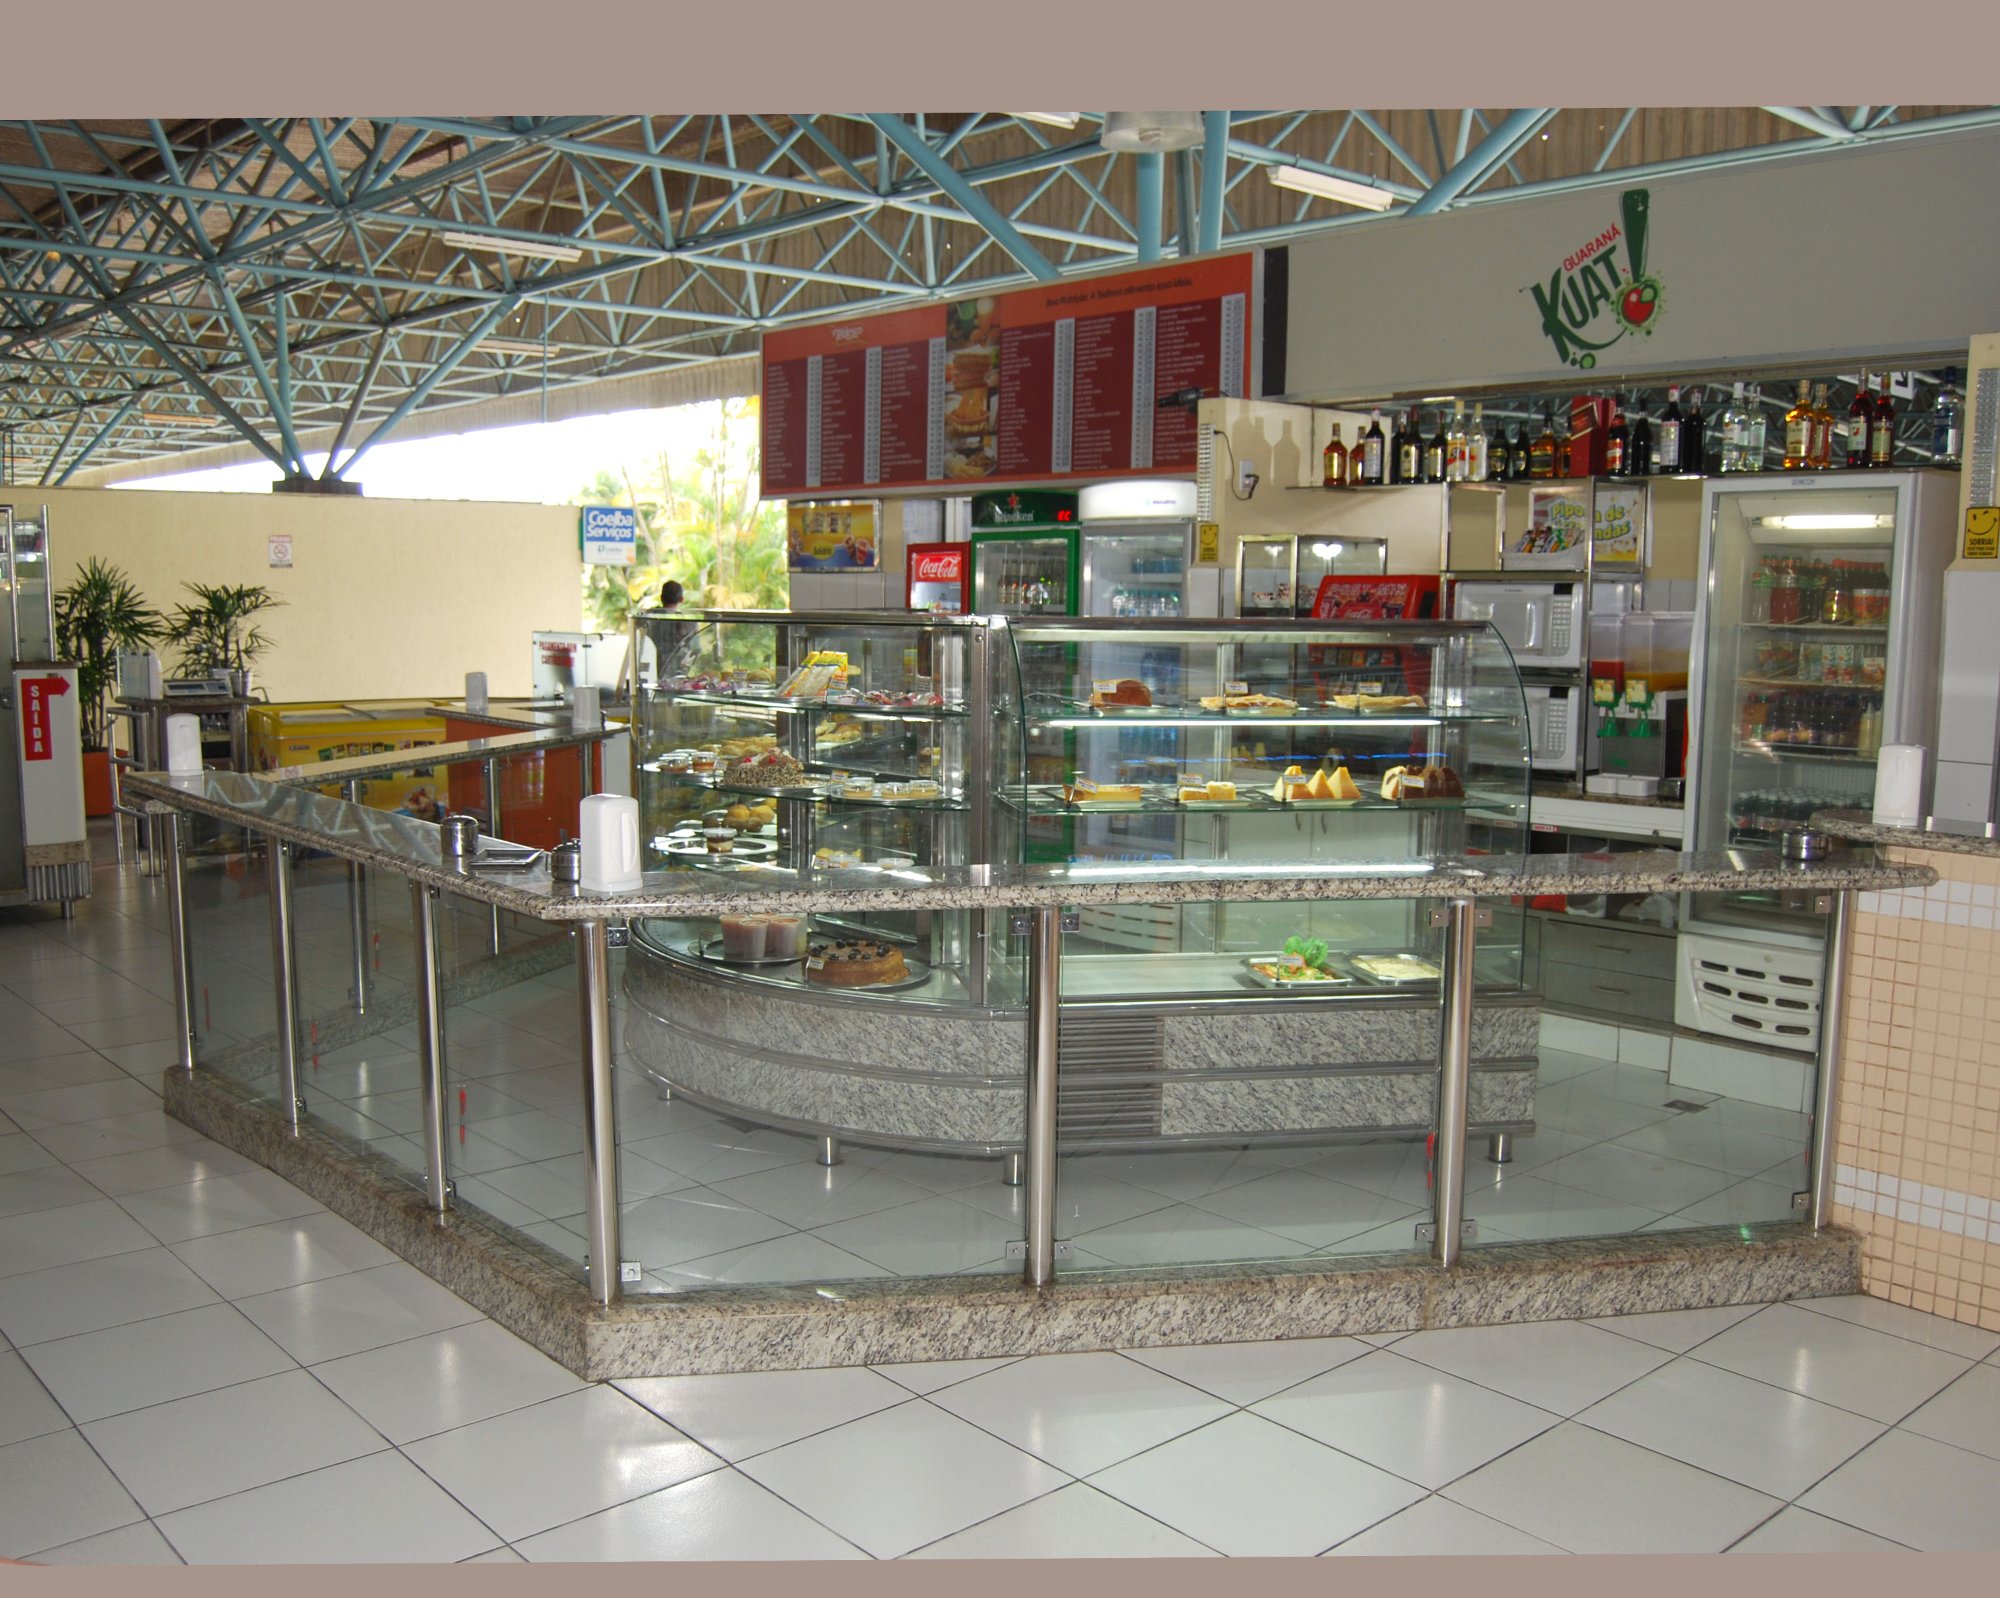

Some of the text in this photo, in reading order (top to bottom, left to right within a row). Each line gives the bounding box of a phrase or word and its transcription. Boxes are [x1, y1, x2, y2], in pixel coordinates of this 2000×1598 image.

[1563, 222, 1622, 272] GUARANÁ
[588, 510, 633, 527] Coelba
[586, 525, 633, 541] Serviços
[919, 555, 962, 578] Coca-Cola
